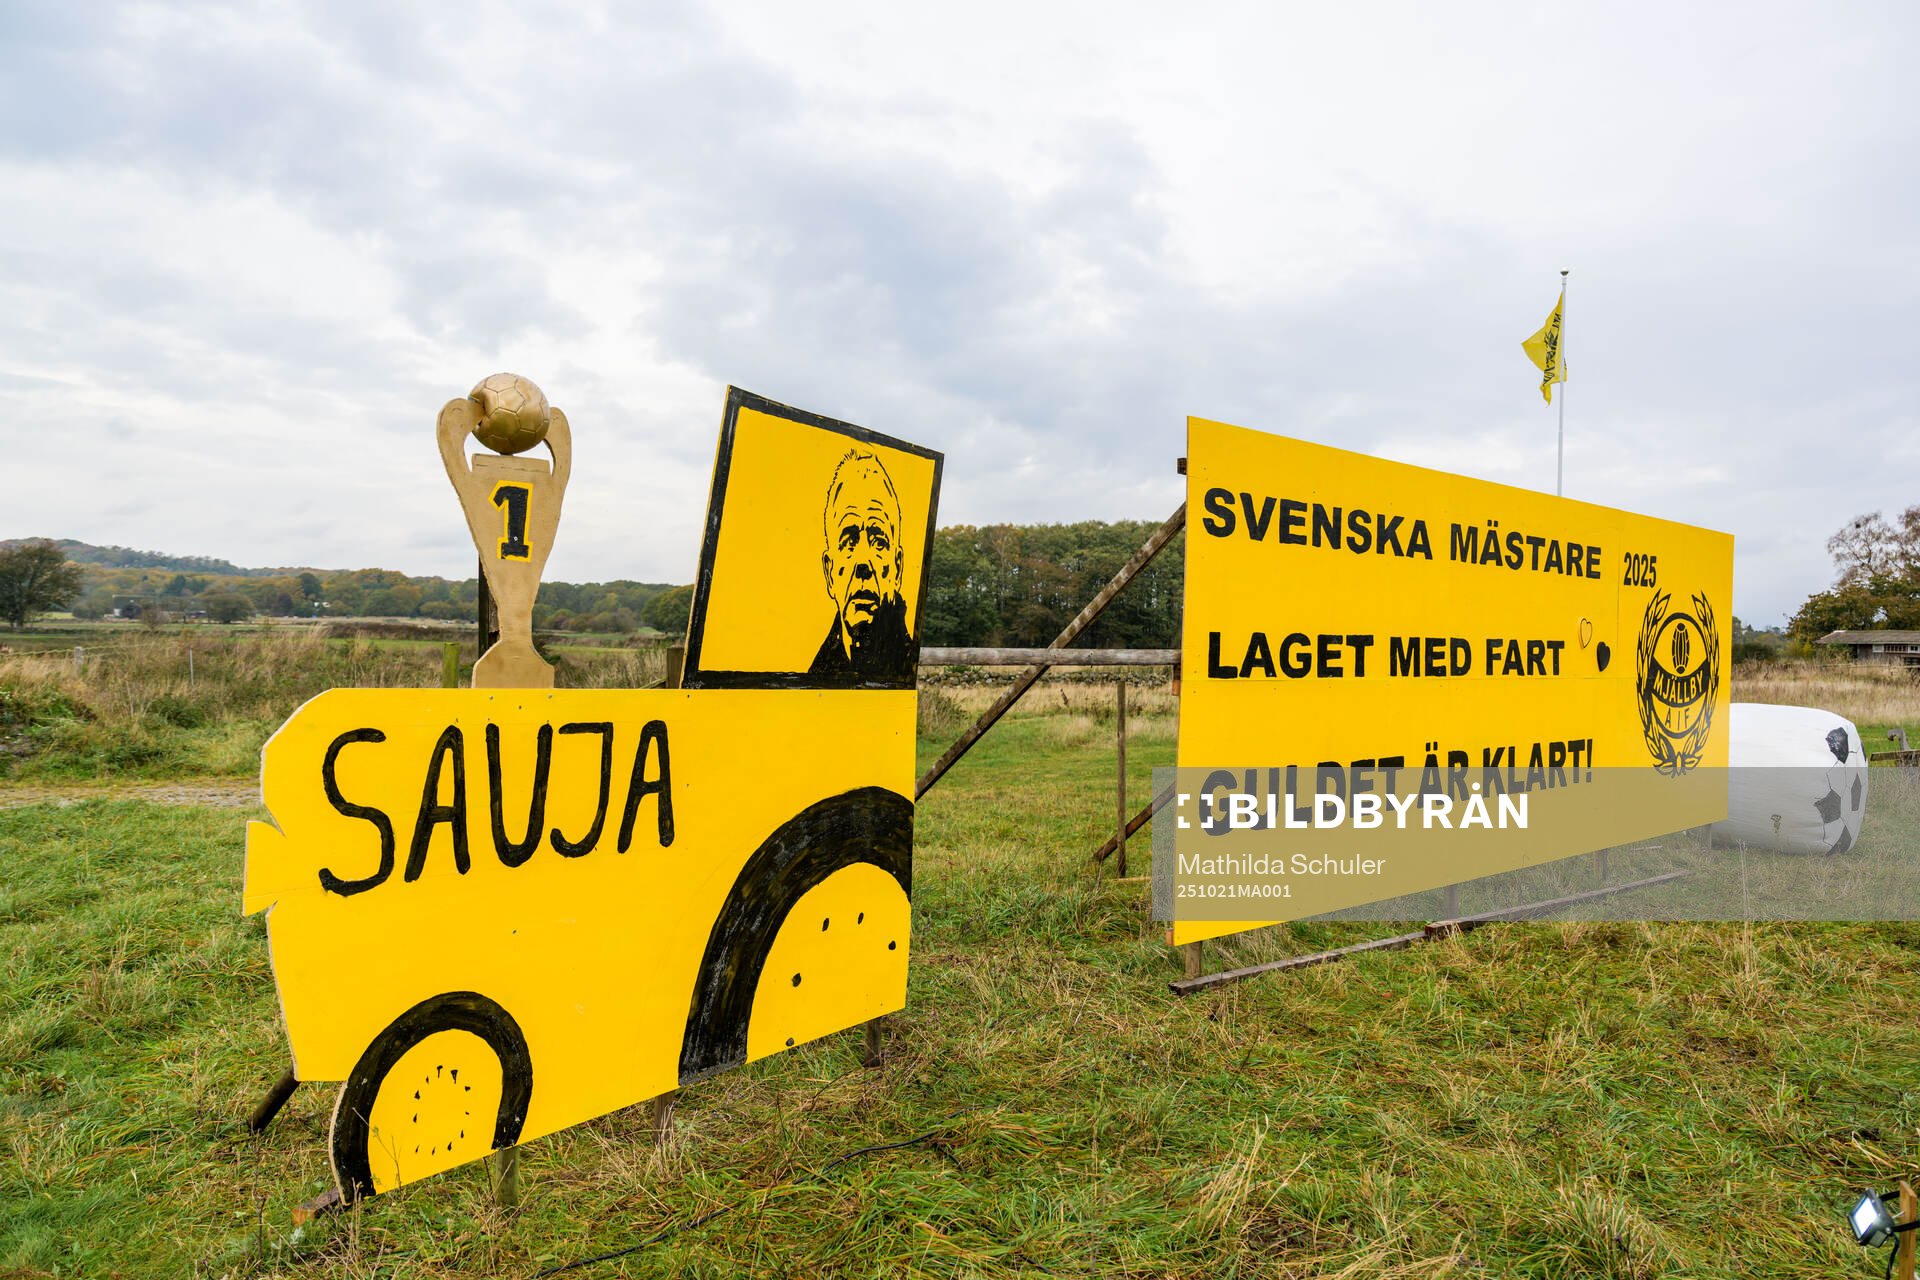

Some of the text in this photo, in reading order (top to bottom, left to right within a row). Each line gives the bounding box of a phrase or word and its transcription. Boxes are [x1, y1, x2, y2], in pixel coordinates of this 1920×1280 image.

[488, 480, 533, 563] 1
[1202, 487, 1657, 588] SVENSKA MÄSTARE 2025
[1208, 631, 1565, 680] LAGET MED FART
[1652, 670, 1705, 704] MJÄLLBY
[318, 719, 676, 896] SAUJA
[1199, 738, 1594, 836] GULDET ÄR KLART!
